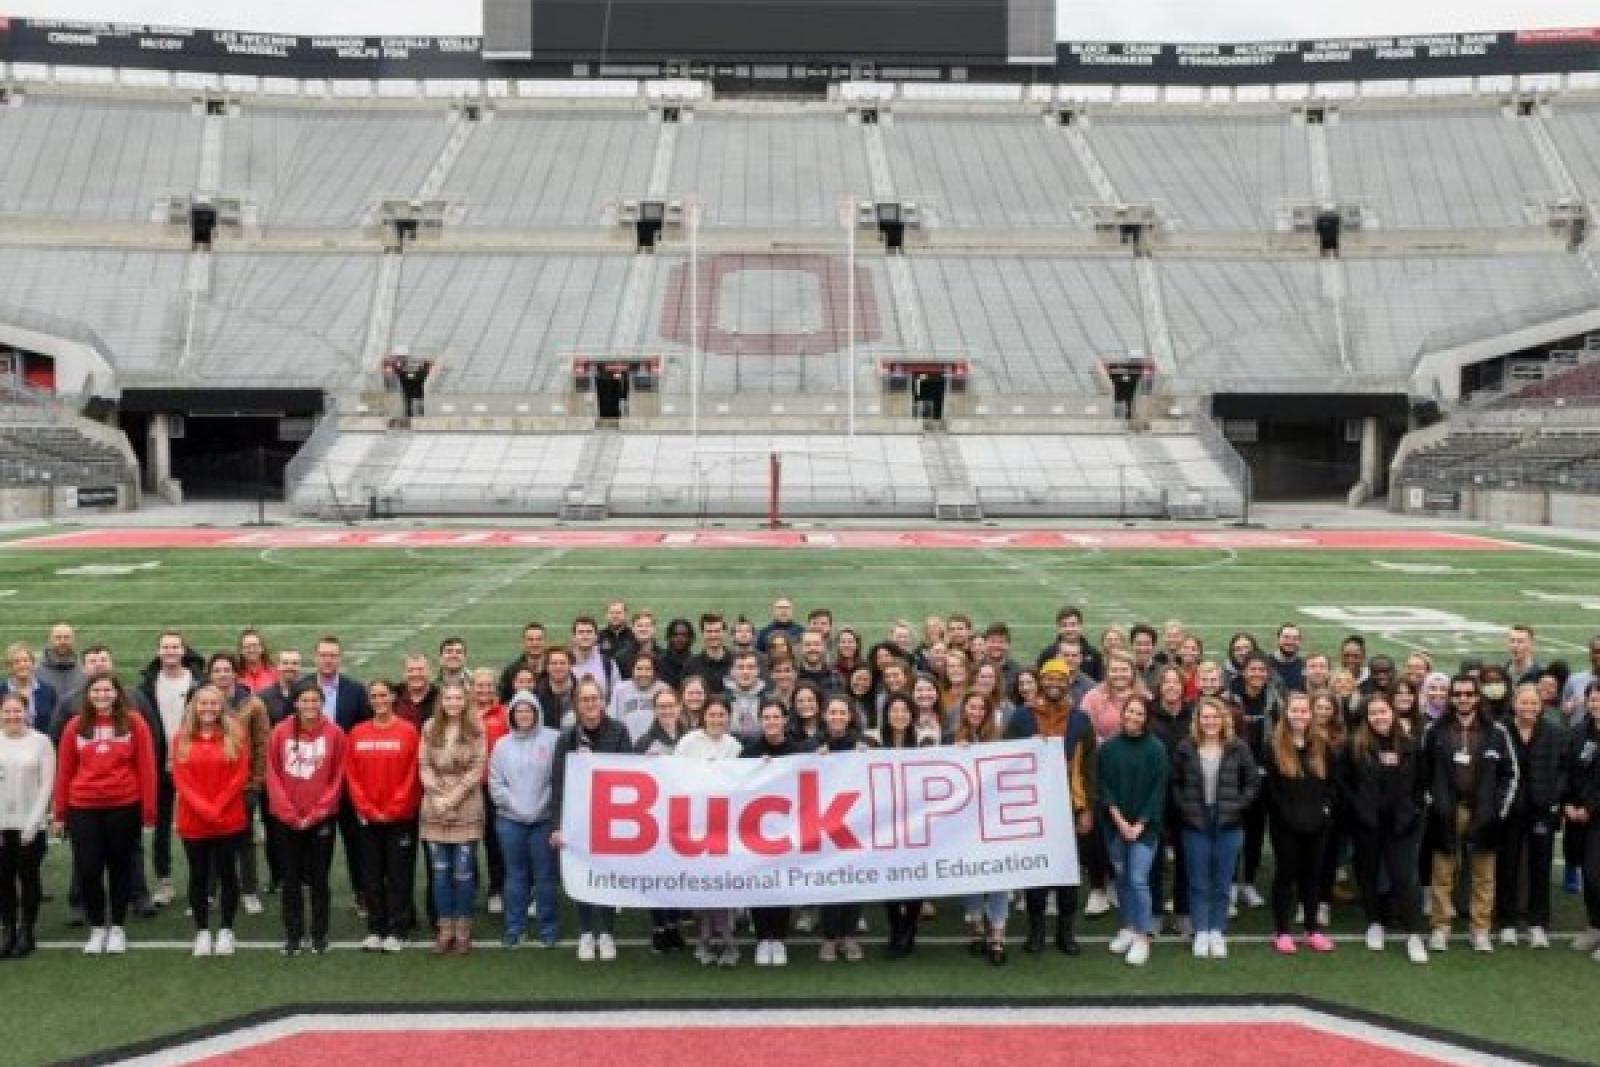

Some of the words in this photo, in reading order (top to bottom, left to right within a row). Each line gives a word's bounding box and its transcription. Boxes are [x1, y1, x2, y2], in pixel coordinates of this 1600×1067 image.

[590, 753, 1043, 857] BuckIPE
[587, 868, 780, 895] Interprofessional
[788, 864, 879, 887] Practice
[887, 861, 928, 882] and
[935, 853, 1049, 879] Education
